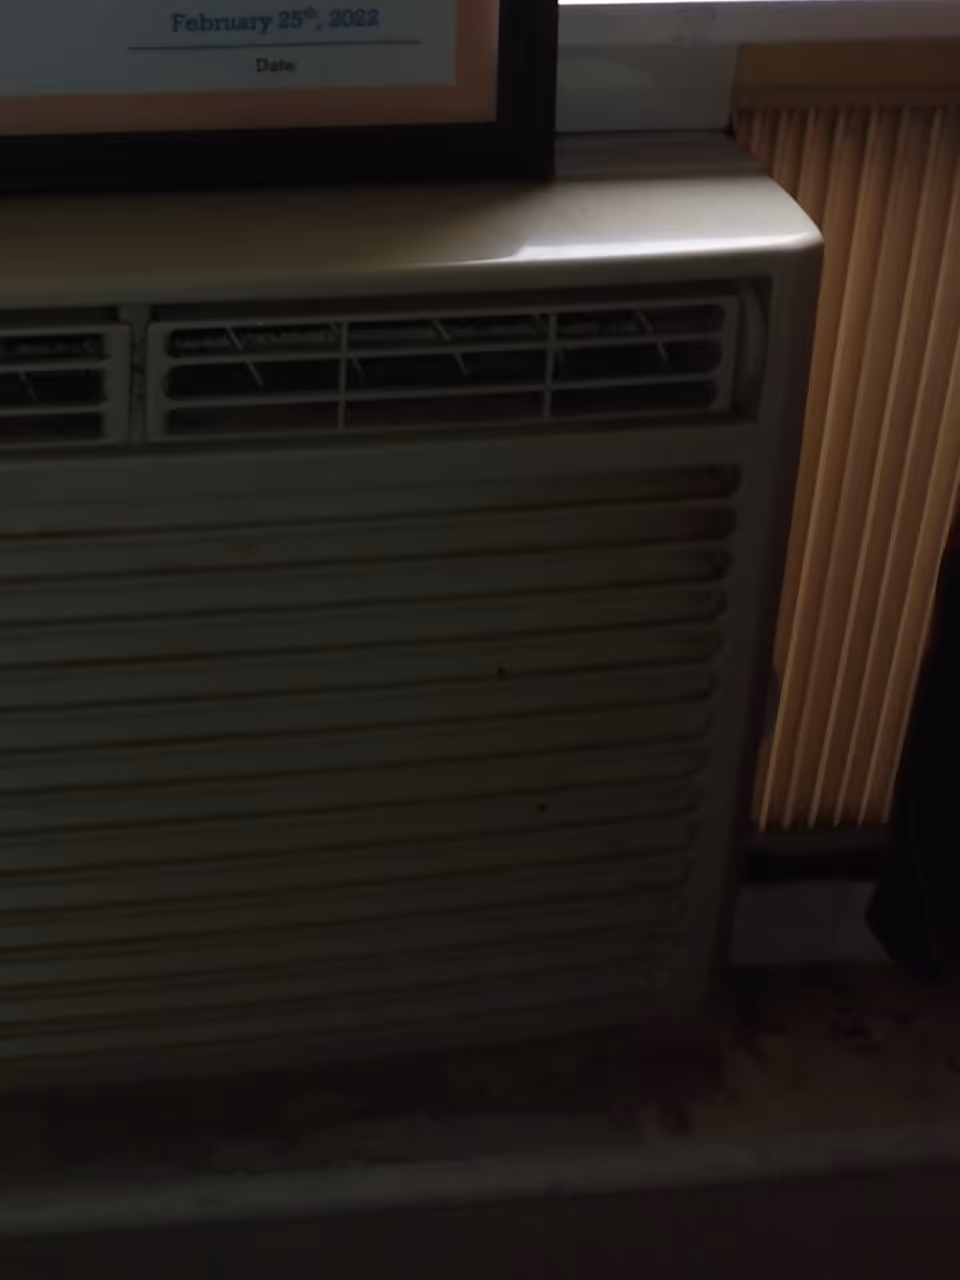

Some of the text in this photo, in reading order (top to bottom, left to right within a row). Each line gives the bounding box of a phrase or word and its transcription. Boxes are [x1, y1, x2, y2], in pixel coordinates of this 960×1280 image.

[171, 11, 273, 34] February
[329, 8, 381, 28] 2022
[255, 57, 296, 73] Date
